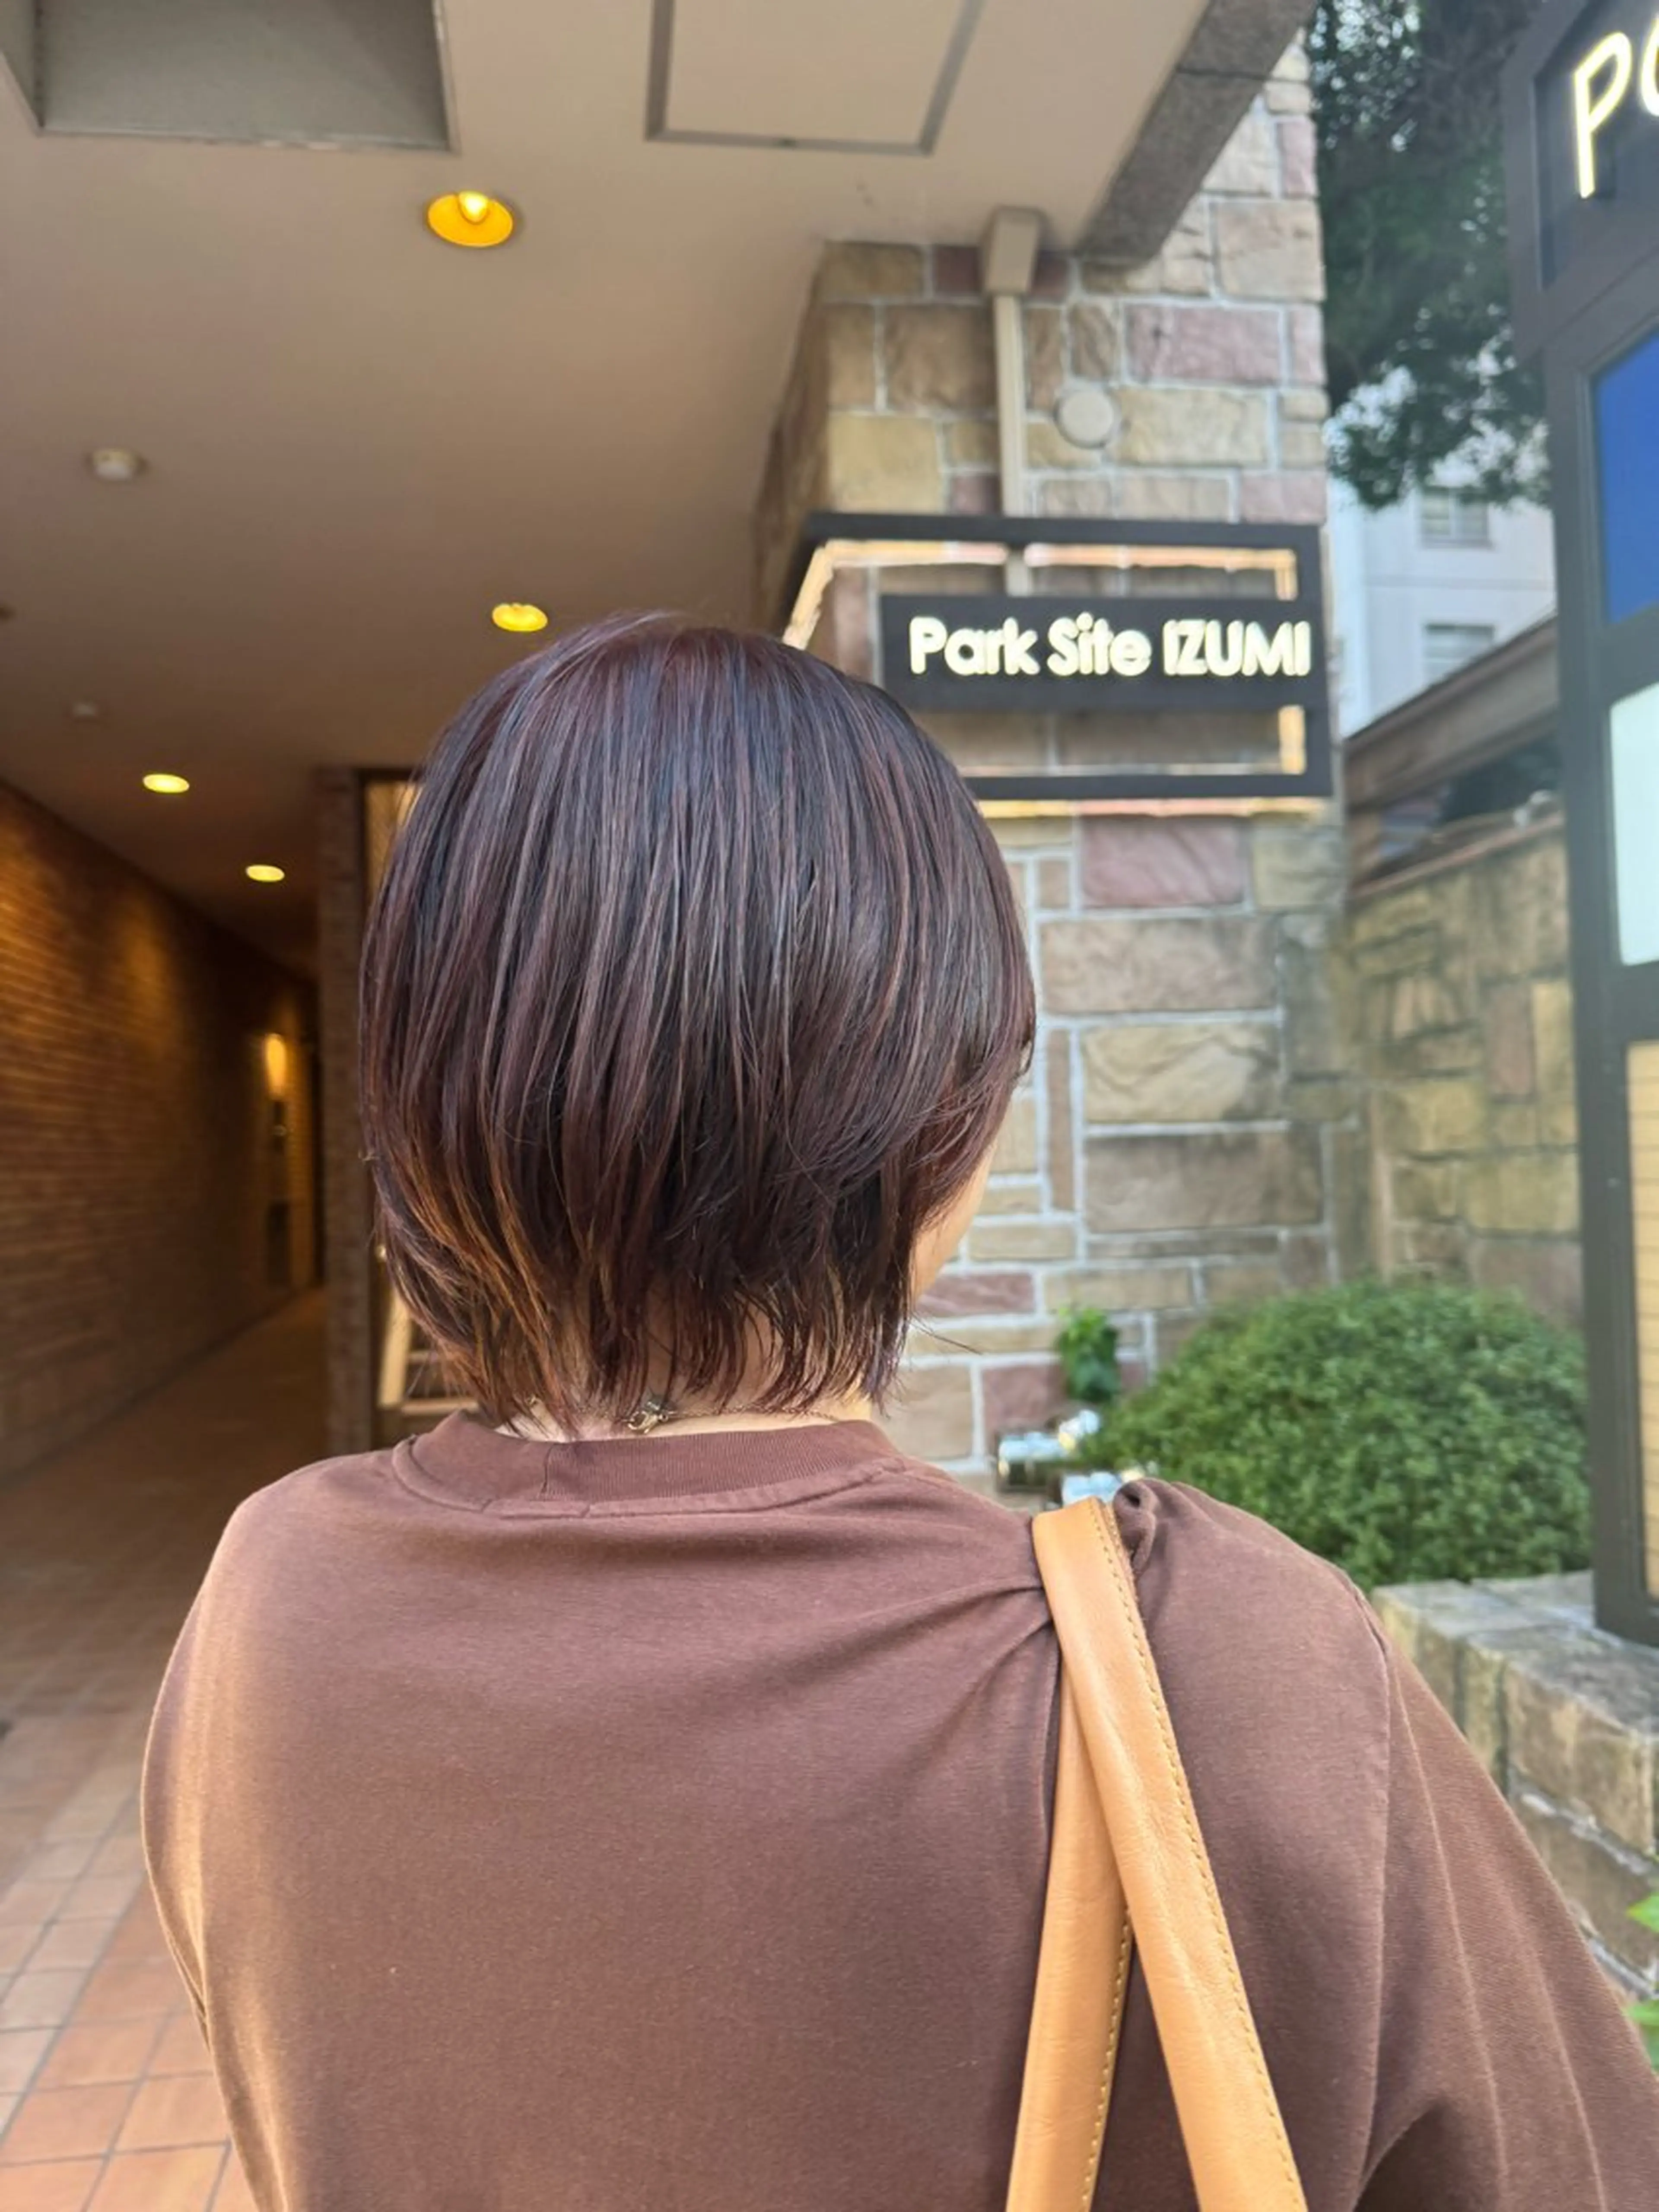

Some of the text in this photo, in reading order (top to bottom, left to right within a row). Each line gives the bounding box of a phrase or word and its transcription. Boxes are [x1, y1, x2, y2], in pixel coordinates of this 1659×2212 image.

[909, 612, 1311, 676] Park Site IZUMI
